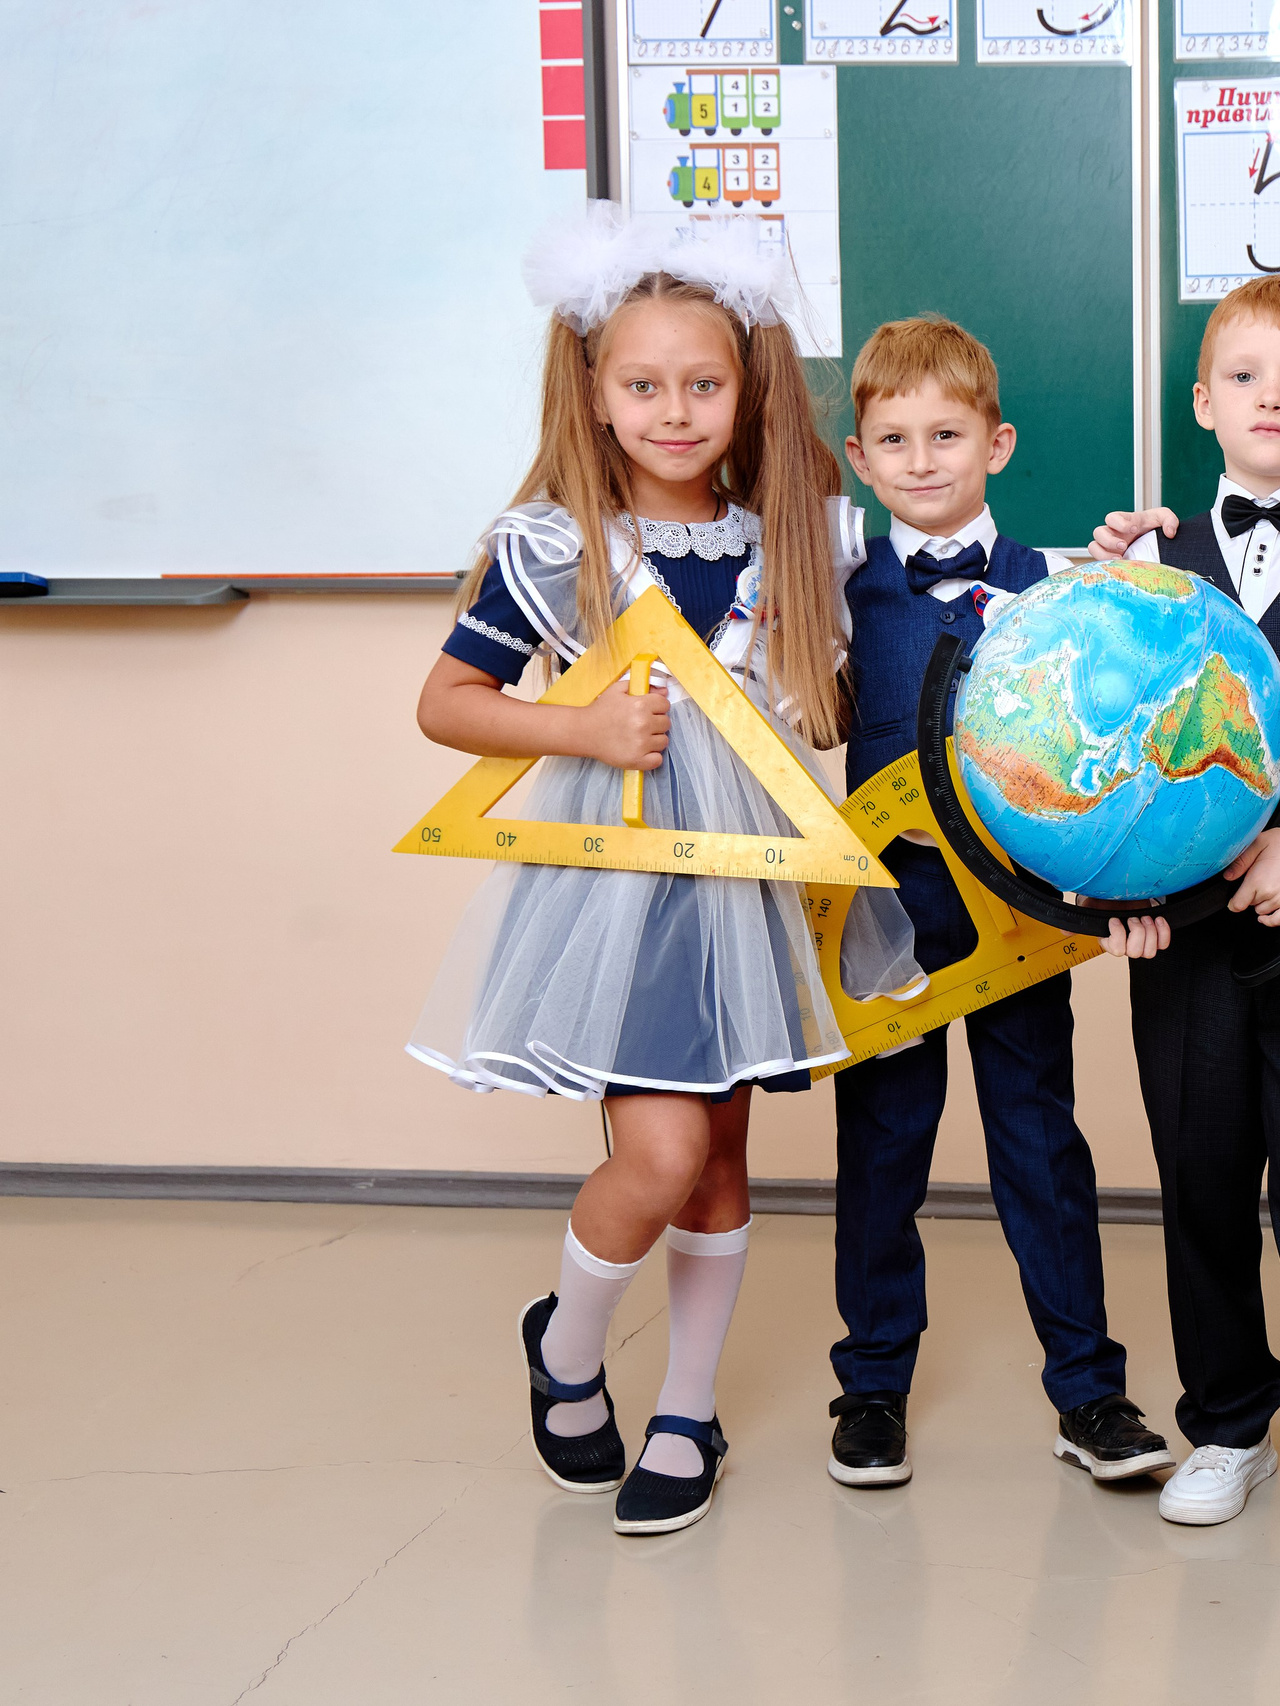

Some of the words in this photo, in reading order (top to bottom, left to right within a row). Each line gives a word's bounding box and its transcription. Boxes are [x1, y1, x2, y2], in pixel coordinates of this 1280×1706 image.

[731, 81, 739, 91] 4
[762, 80, 770, 90] 3
[700, 103, 708, 119] 5
[732, 102, 738, 112] 1
[763, 102, 771, 112] 2
[732, 154, 740, 165] 3
[761, 154, 769, 165] 2
[702, 176, 711, 191] 4
[733, 177, 740, 186] 1
[763, 175, 771, 186] 2
[891, 776, 907, 791] 80
[899, 788, 920, 807] 100
[860, 800, 876, 816] 70
[871, 810, 890, 829] 110
[421, 827, 442, 842] 50
[496, 831, 517, 847] 40
[583, 837, 605, 853] 30
[673, 842, 695, 858] 20
[765, 848, 786, 864] 10
[843, 854, 855, 862] cm
[817, 898, 832, 918] 140
[887, 1020, 902, 1033] 10
[975, 981, 990, 994] 20
[1063, 942, 1078, 955] 30
